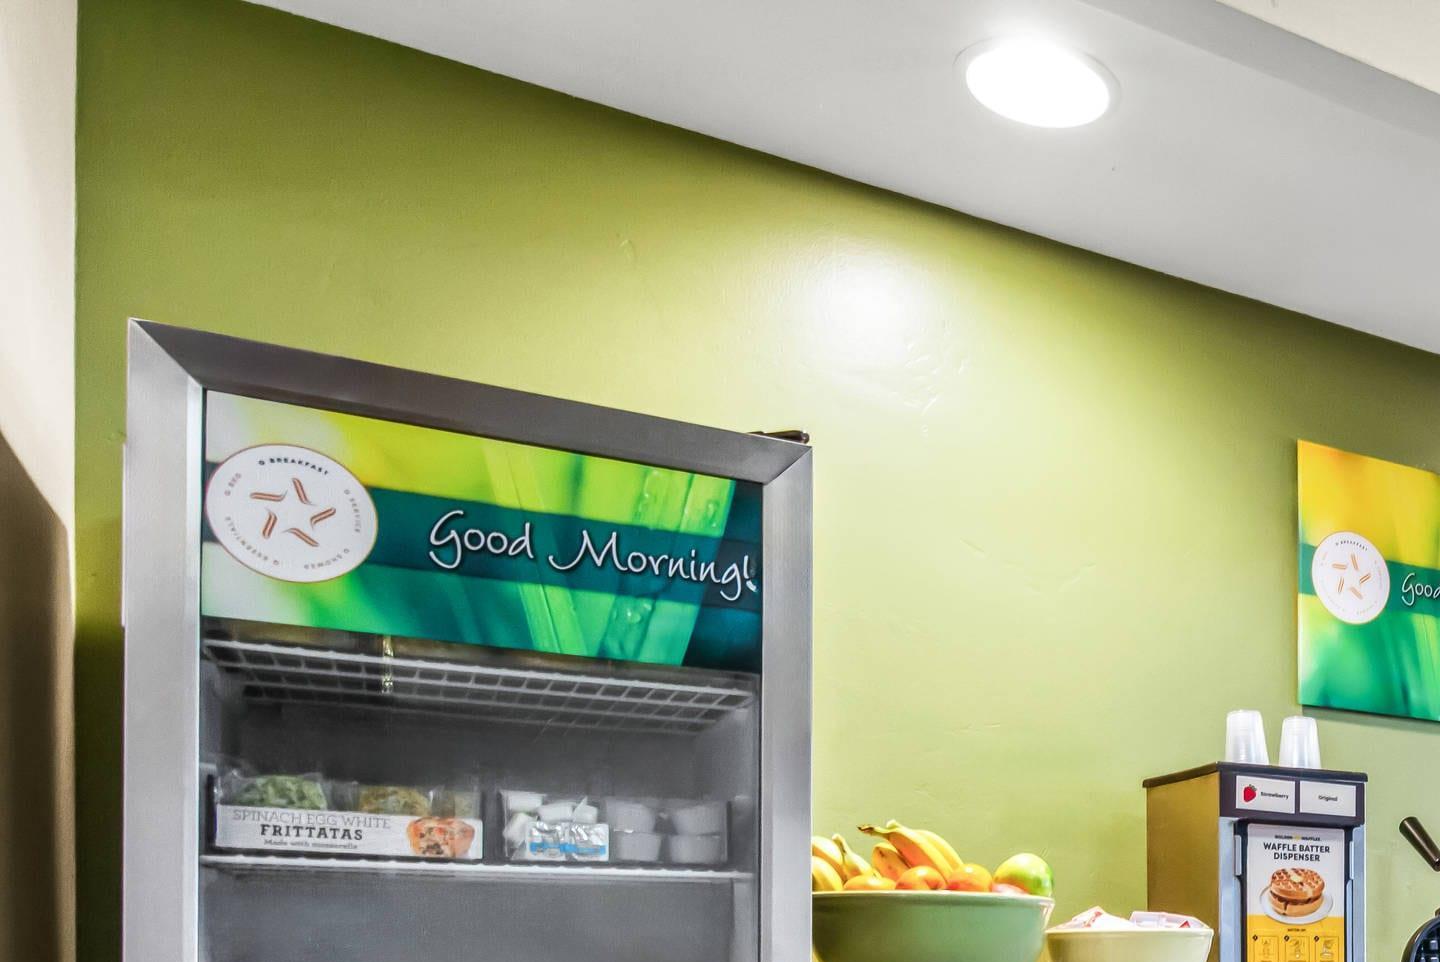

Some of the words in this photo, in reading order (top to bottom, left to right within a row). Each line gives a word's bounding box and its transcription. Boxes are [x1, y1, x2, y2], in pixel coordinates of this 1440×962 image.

[269, 457, 329, 476] BREAKFAST
[429, 510, 534, 569] Good
[548, 530, 758, 601] Morning!
[233, 809, 301, 824] SPINACH
[307, 813, 337, 826] EGG
[340, 815, 392, 829] WHITE
[260, 823, 363, 841] FRITTATAS
[1263, 842, 1297, 852] WAFFLE
[1299, 844, 1330, 853] BATTER
[1273, 852, 1321, 862] DISPENSER
